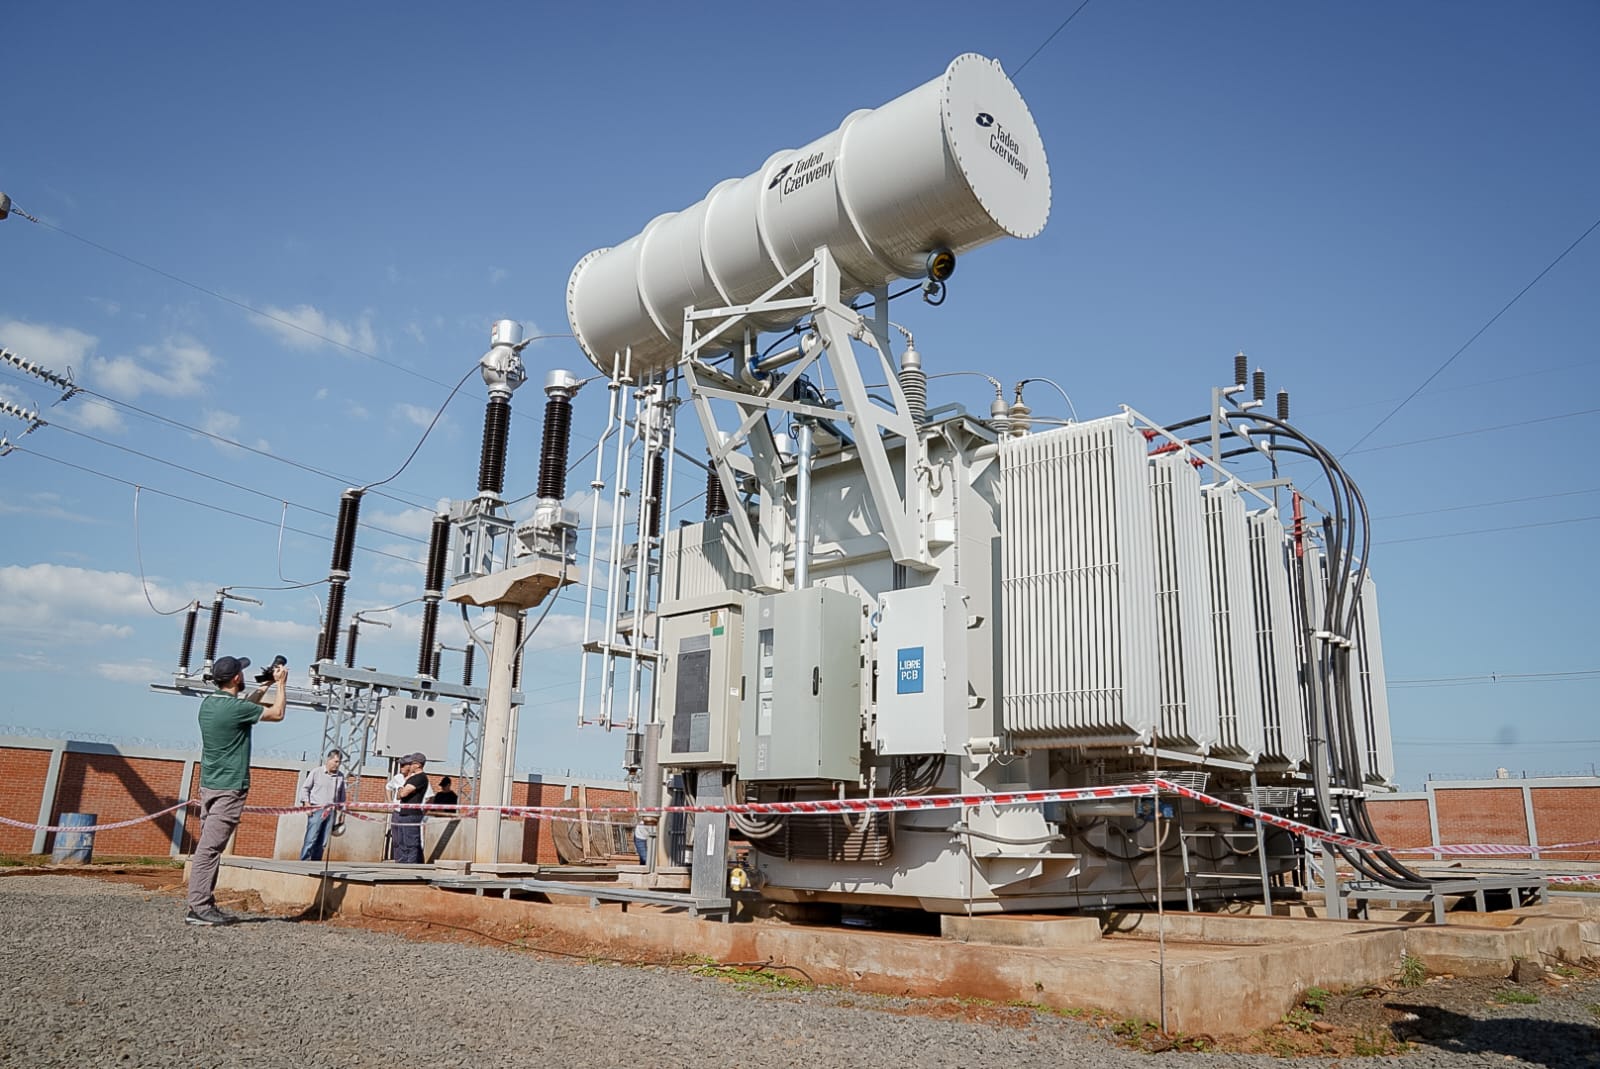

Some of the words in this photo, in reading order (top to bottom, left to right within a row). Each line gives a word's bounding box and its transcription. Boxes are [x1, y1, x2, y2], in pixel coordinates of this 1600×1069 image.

[997, 122, 1019, 155] Tadeo
[794, 152, 824, 175] Tadeo
[990, 133, 1029, 180] Czerweny
[784, 160, 835, 195] Czerweny
[899, 658, 921, 670] LIBRE
[901, 669, 919, 681] PCB
